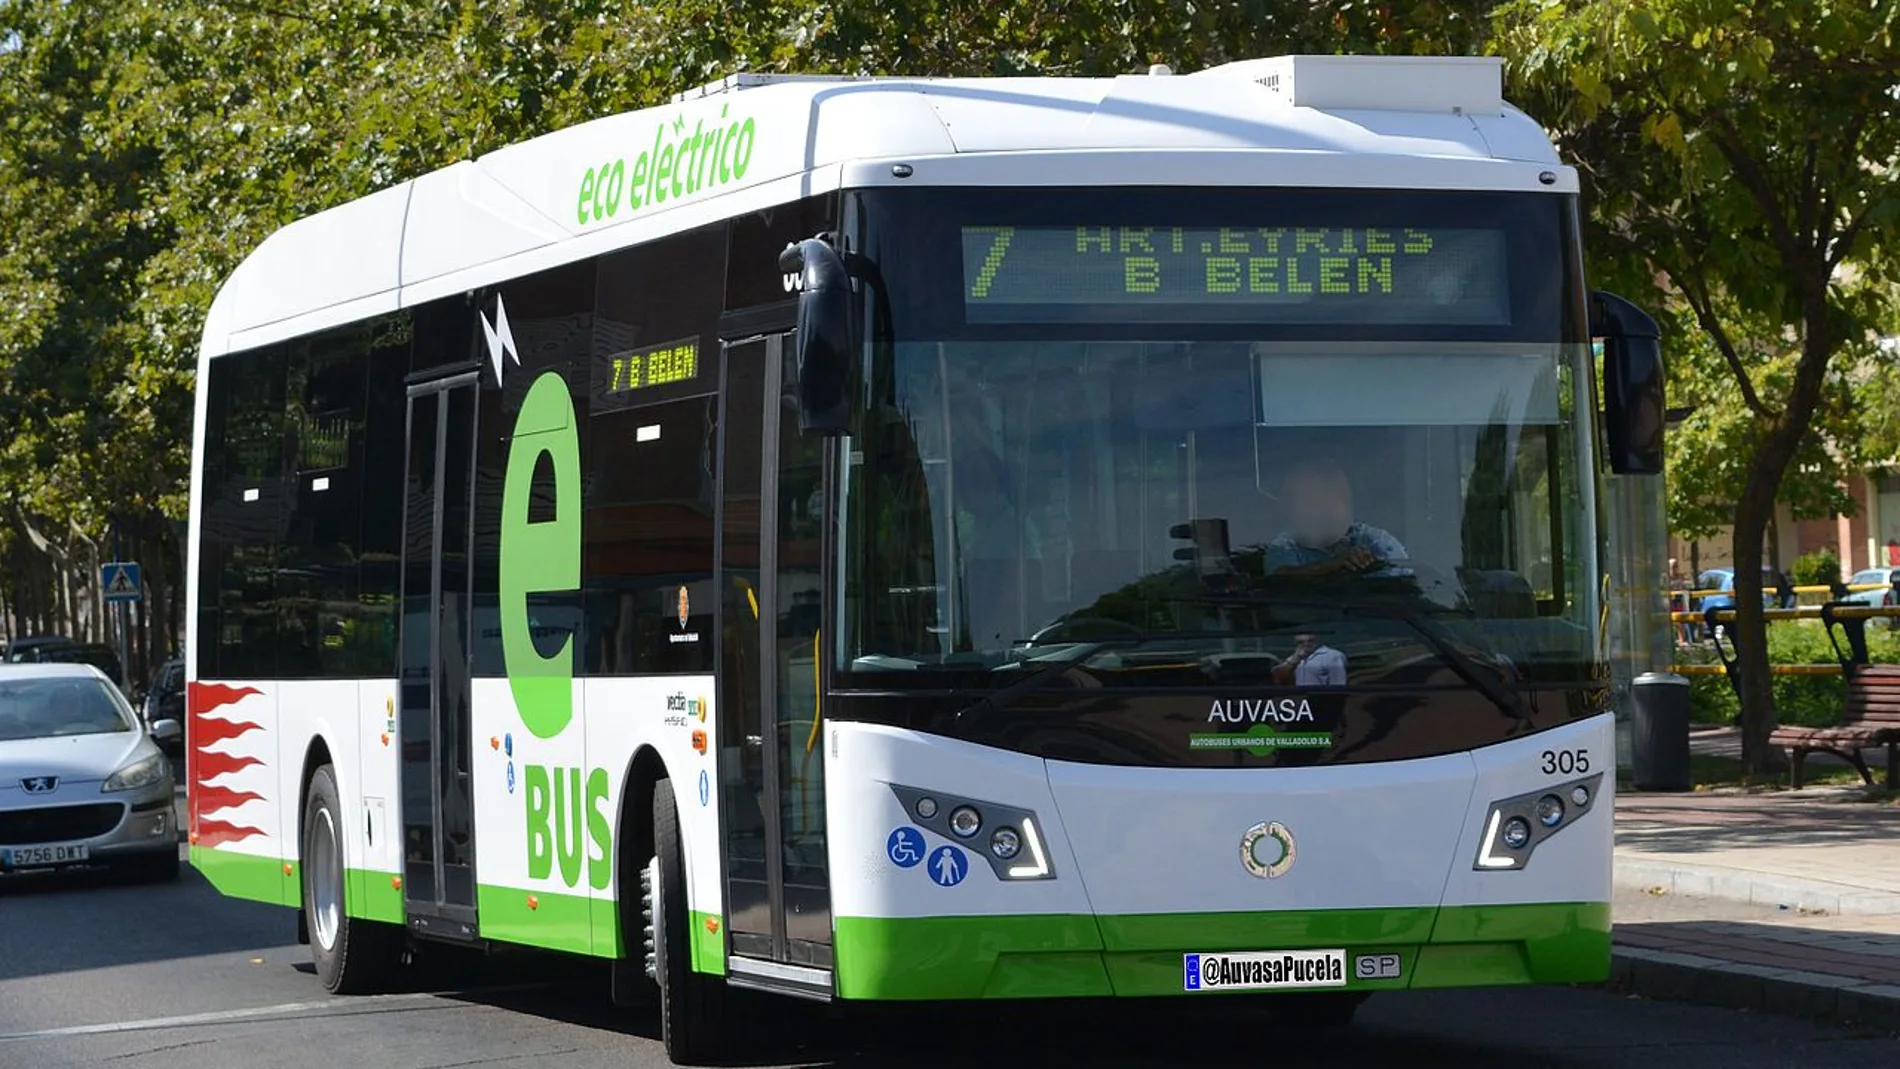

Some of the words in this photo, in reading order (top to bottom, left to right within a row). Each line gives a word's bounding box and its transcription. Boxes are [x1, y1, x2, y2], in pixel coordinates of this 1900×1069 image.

[577, 159, 625, 225] eco
[963, 227, 1015, 298] 7
[1125, 257, 1160, 293] B
[1206, 257, 1392, 293] BELEN
[612, 359, 622, 391] 7
[648, 345, 694, 385] BELEN
[500, 371, 582, 738] e
[1207, 699, 1314, 722] AUVASA
[1190, 738, 1231, 746] AUTOBUSES
[1232, 738, 1265, 746] URBANOS
[1265, 737, 1276, 746] DE
[1276, 736, 1317, 745] VALLADOLID
[1541, 749, 1589, 774] 305
[525, 765, 613, 891] BUS
[13, 848, 51, 864] 5756
[56, 844, 84, 860] DWT
[1203, 954, 1342, 985] @AuvasaPucela
[1359, 957, 1396, 975] SP
